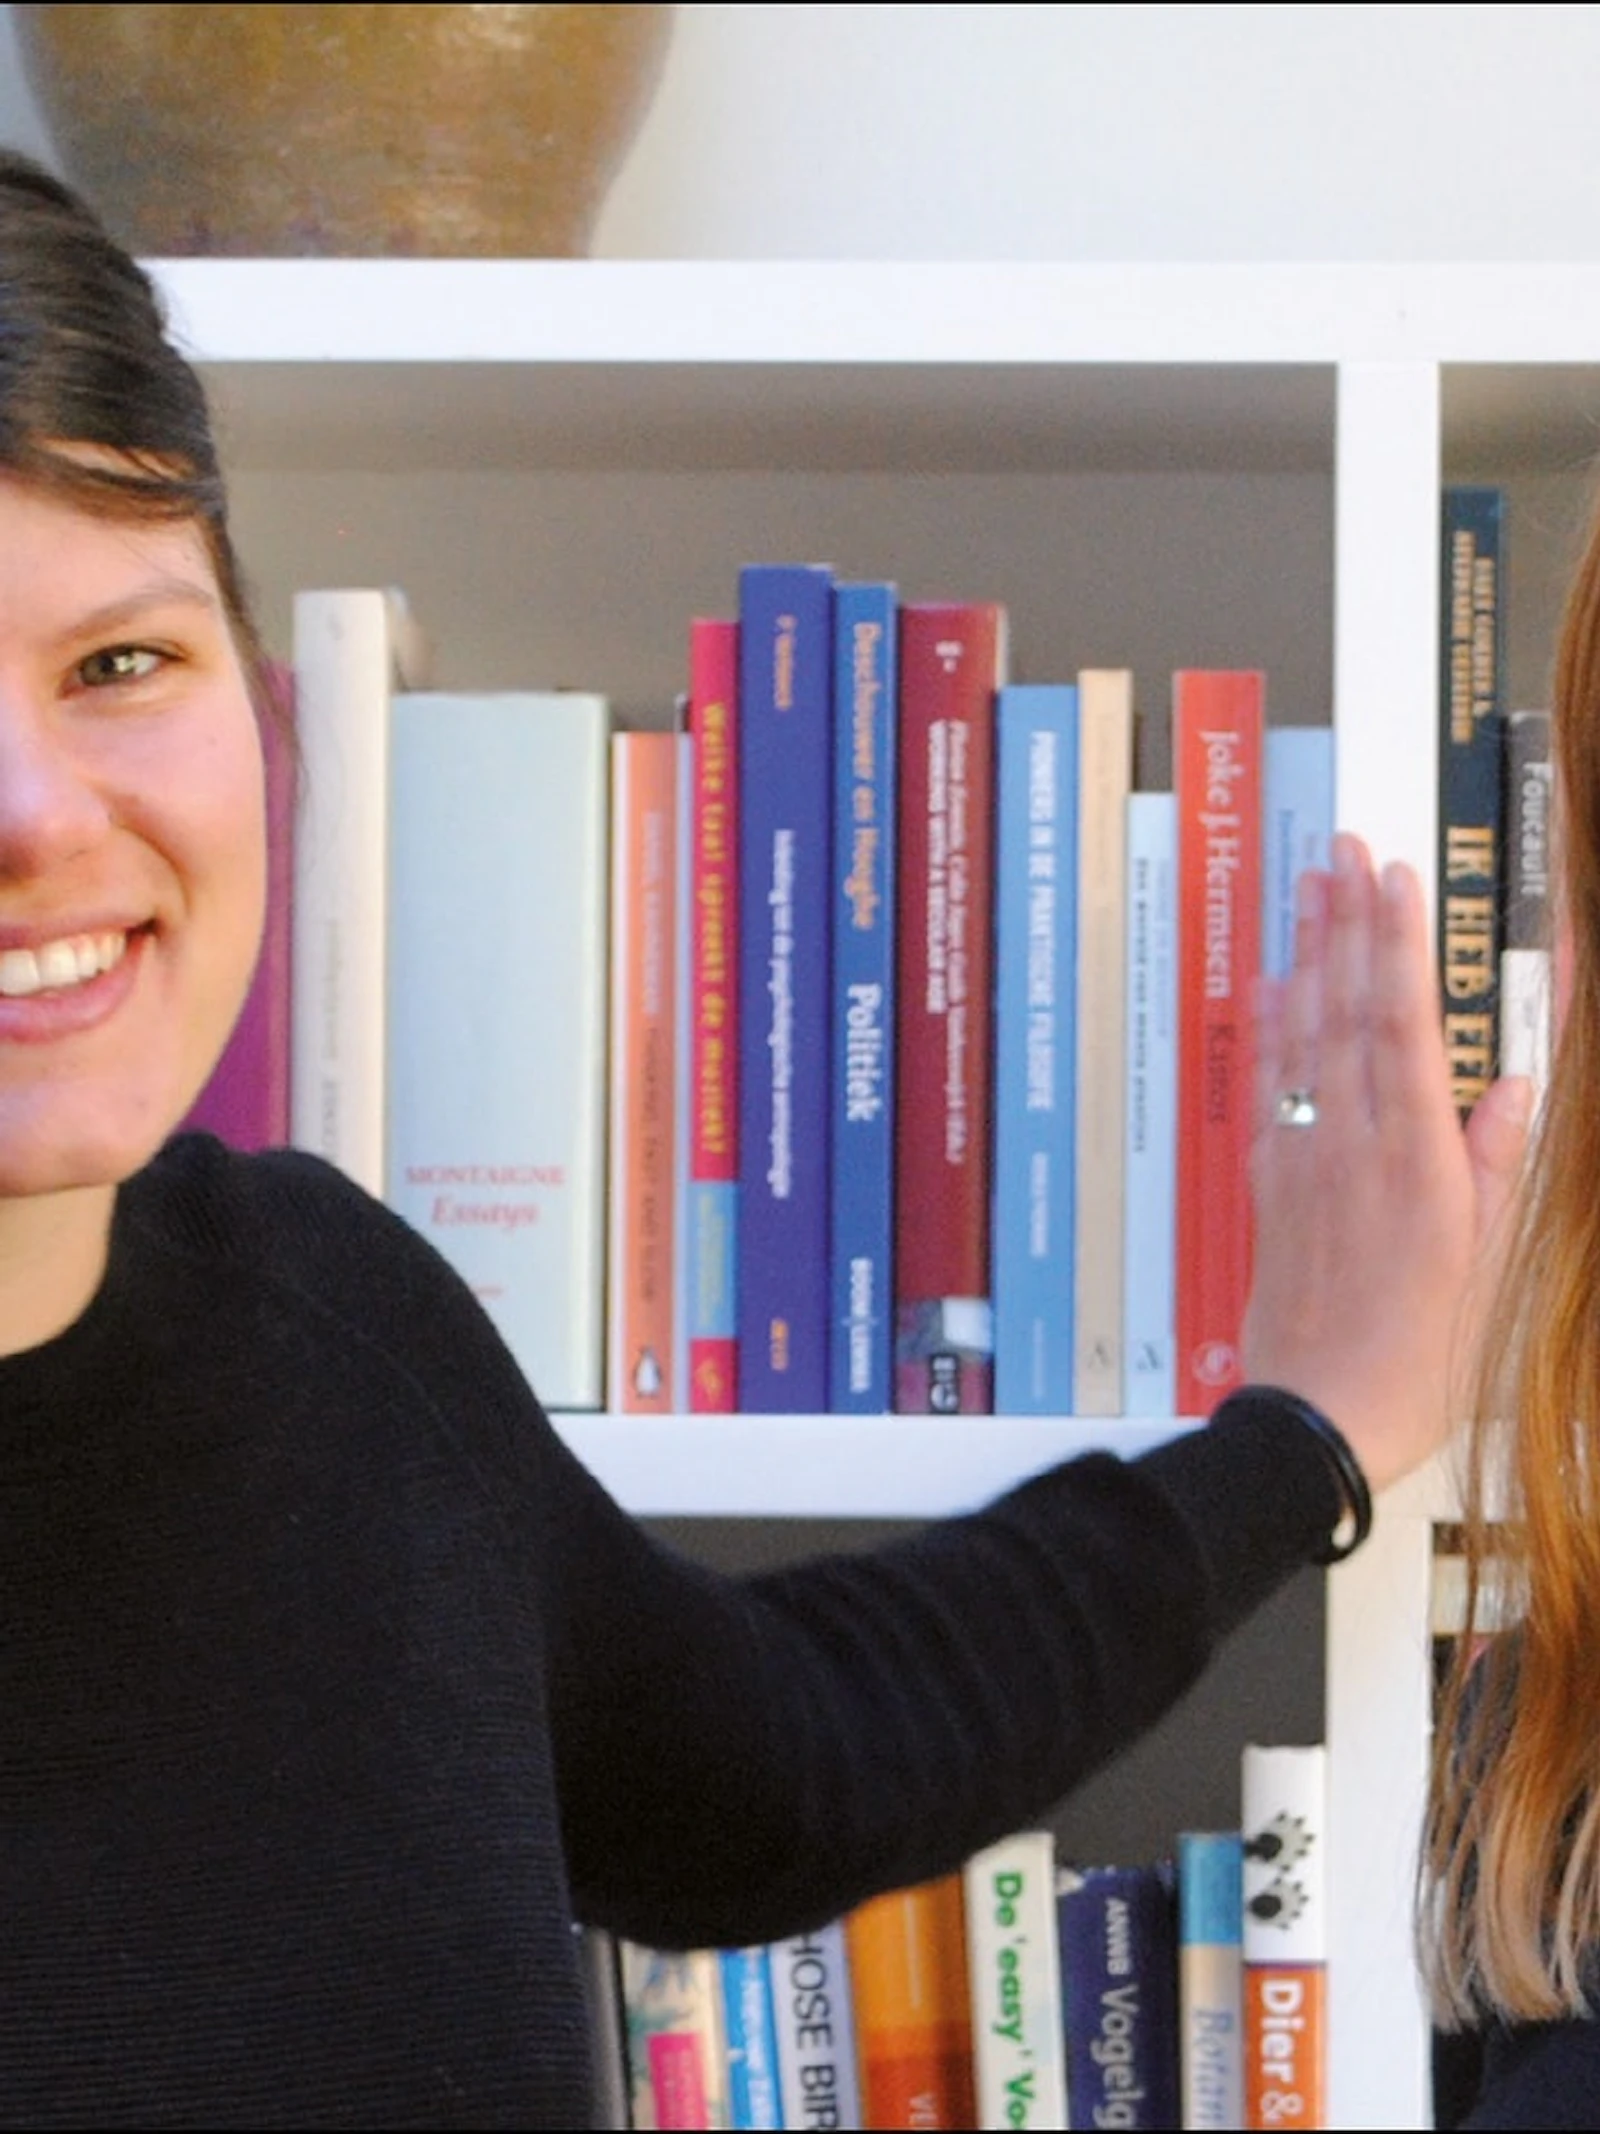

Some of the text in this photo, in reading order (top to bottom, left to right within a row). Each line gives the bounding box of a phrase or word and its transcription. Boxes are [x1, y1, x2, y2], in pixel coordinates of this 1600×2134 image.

[701, 703, 725, 792] Welke
[1198, 731, 1245, 807] Joke
[701, 804, 725, 861] taal
[1446, 825, 1496, 879] IK
[1520, 761, 1553, 898] Foucault
[697, 873, 725, 982] spreekt
[1205, 837, 1241, 999] Hermsen
[1445, 896, 1495, 998] HEB
[701, 992, 725, 1028] de
[846, 982, 882, 1124] Politiek
[431, 1196, 540, 1231] Essays
[993, 1871, 1024, 1928] De
[1103, 1895, 1131, 1976] ANWB
[790, 1935, 833, 2047] HOSE
[1260, 1978, 1306, 2126] Dier &
[1004, 2072, 1038, 2129] Vo
